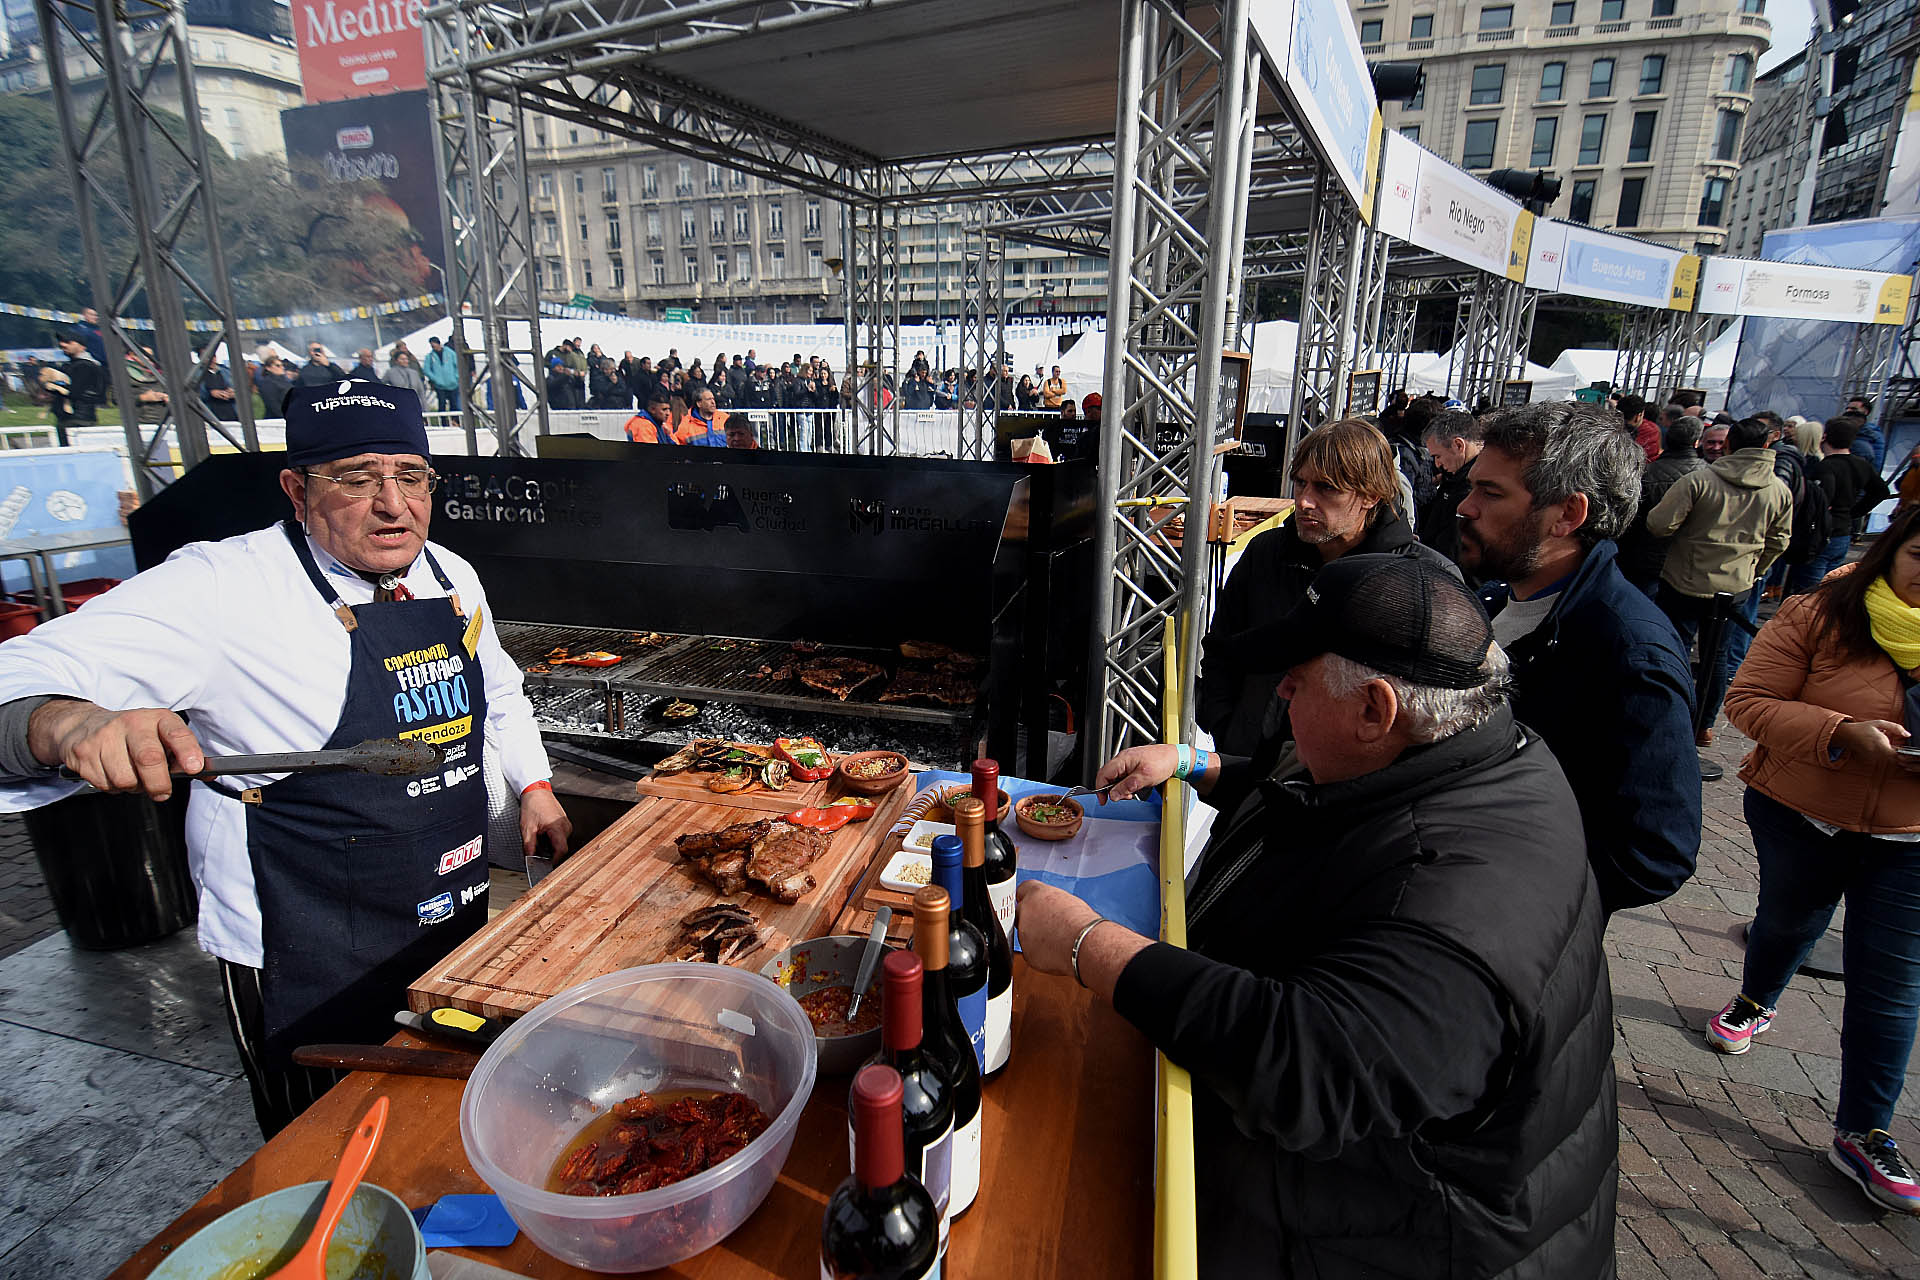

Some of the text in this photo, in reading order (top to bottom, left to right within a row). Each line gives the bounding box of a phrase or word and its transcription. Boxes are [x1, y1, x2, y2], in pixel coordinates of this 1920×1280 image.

[1449, 200, 1485, 234] Río Negro
[1591, 256, 1647, 281] Buenos Aires
[1786, 285, 1830, 300] Formosa
[311, 399, 396, 412] Tupungato
[384, 643, 449, 672] CAMPEONATO
[395, 659, 454, 692] FEDERAL
[393, 674, 470, 723] ASADO
[411, 723, 466, 742] Mendoza
[443, 742, 467, 758] apital
[439, 834, 483, 876] COTO
